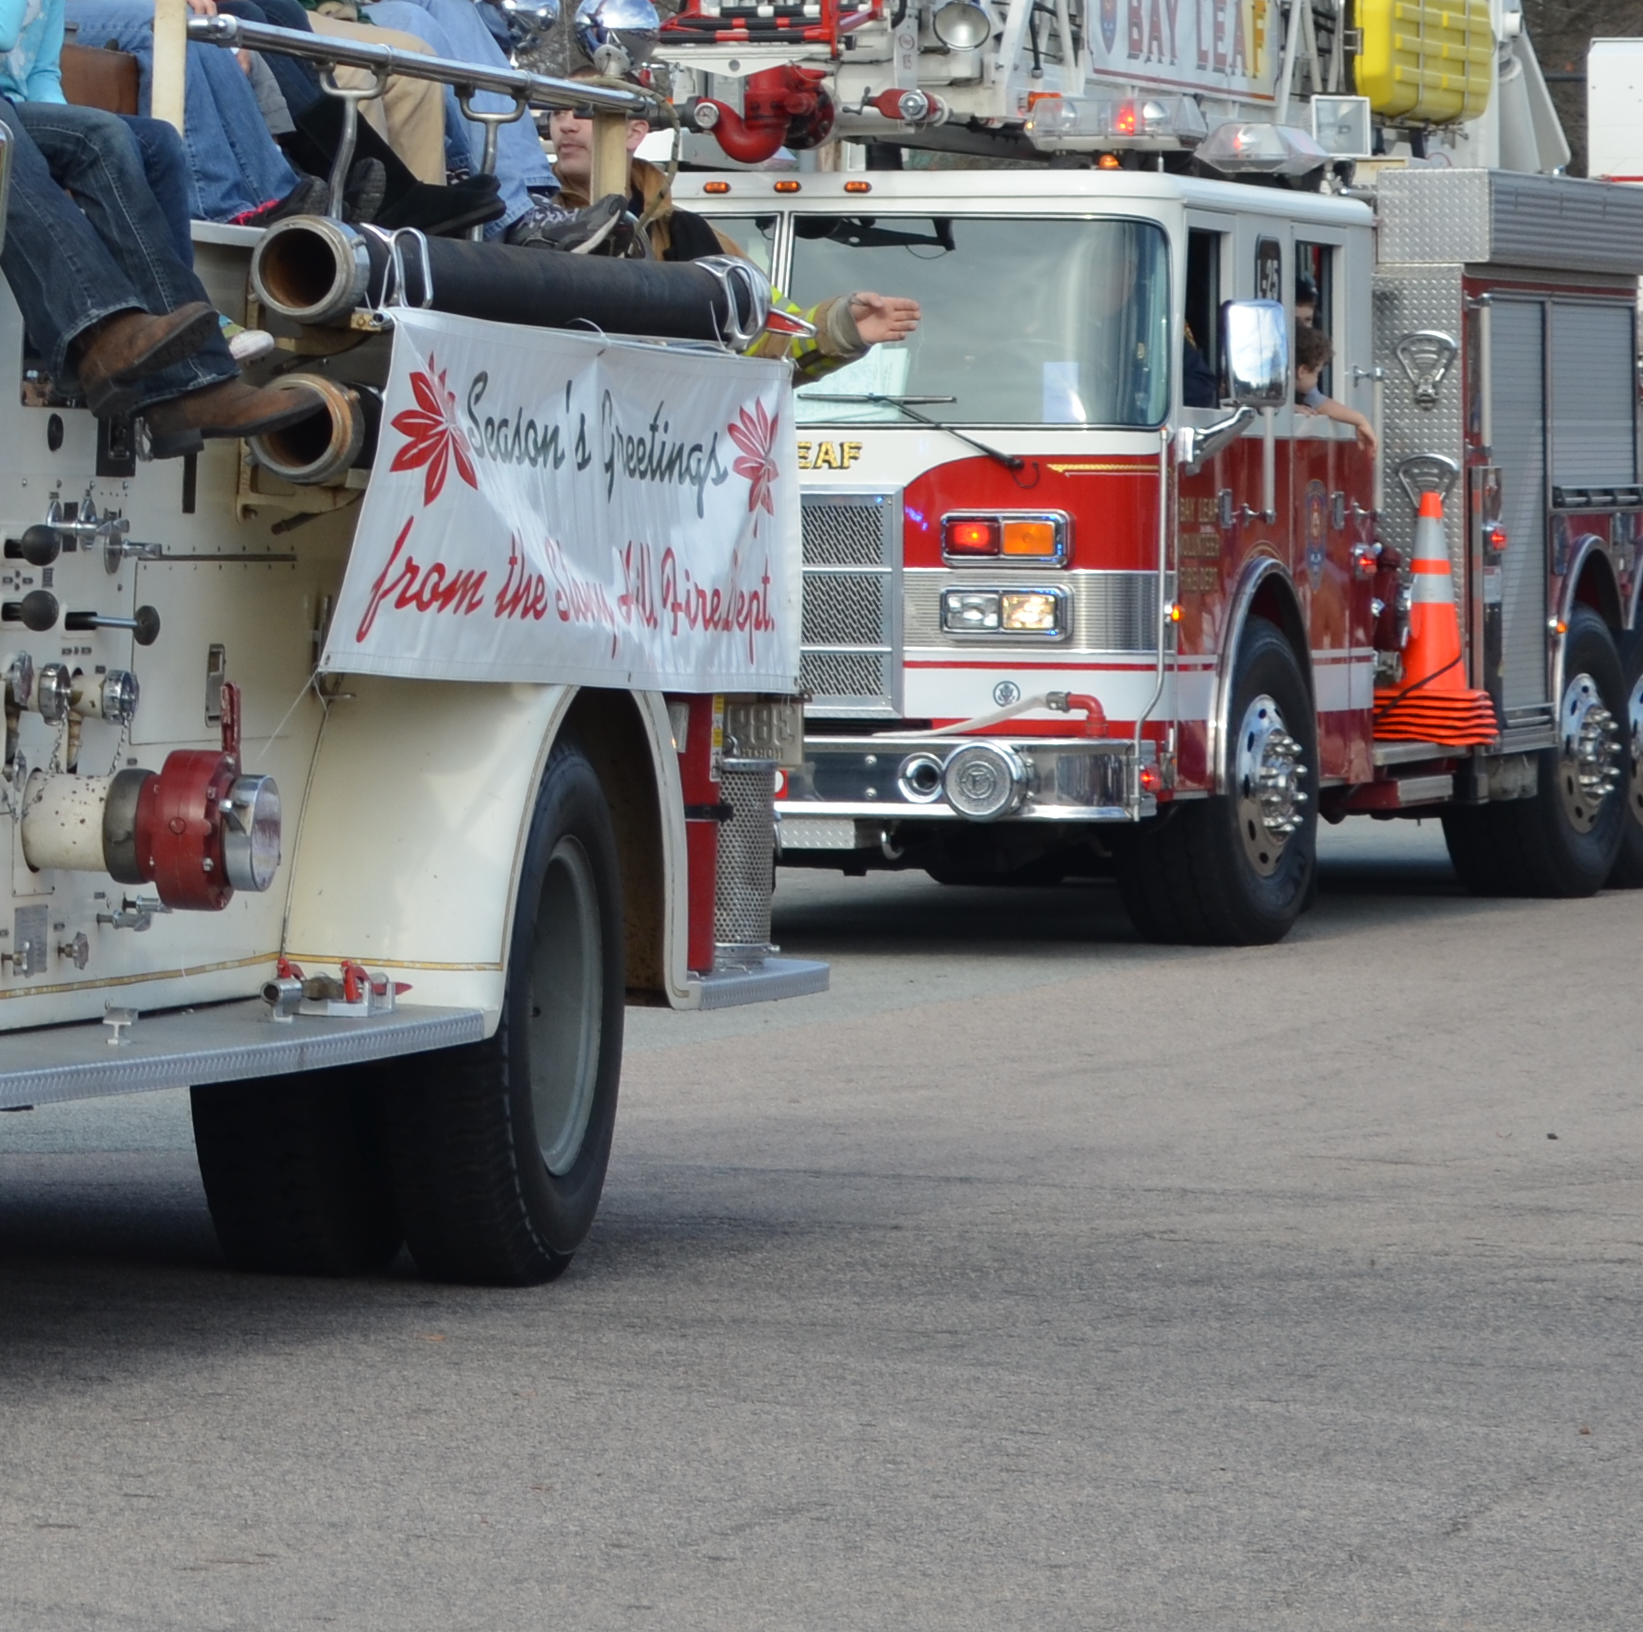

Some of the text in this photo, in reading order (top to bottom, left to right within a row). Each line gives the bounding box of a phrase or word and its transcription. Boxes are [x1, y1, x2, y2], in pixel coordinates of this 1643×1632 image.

[467, 371, 729, 519] Season's Greetings
[797, 441, 863, 469] EAF
[356, 515, 488, 643] from
[494, 528, 548, 621] the
[660, 547, 721, 636] Fire
